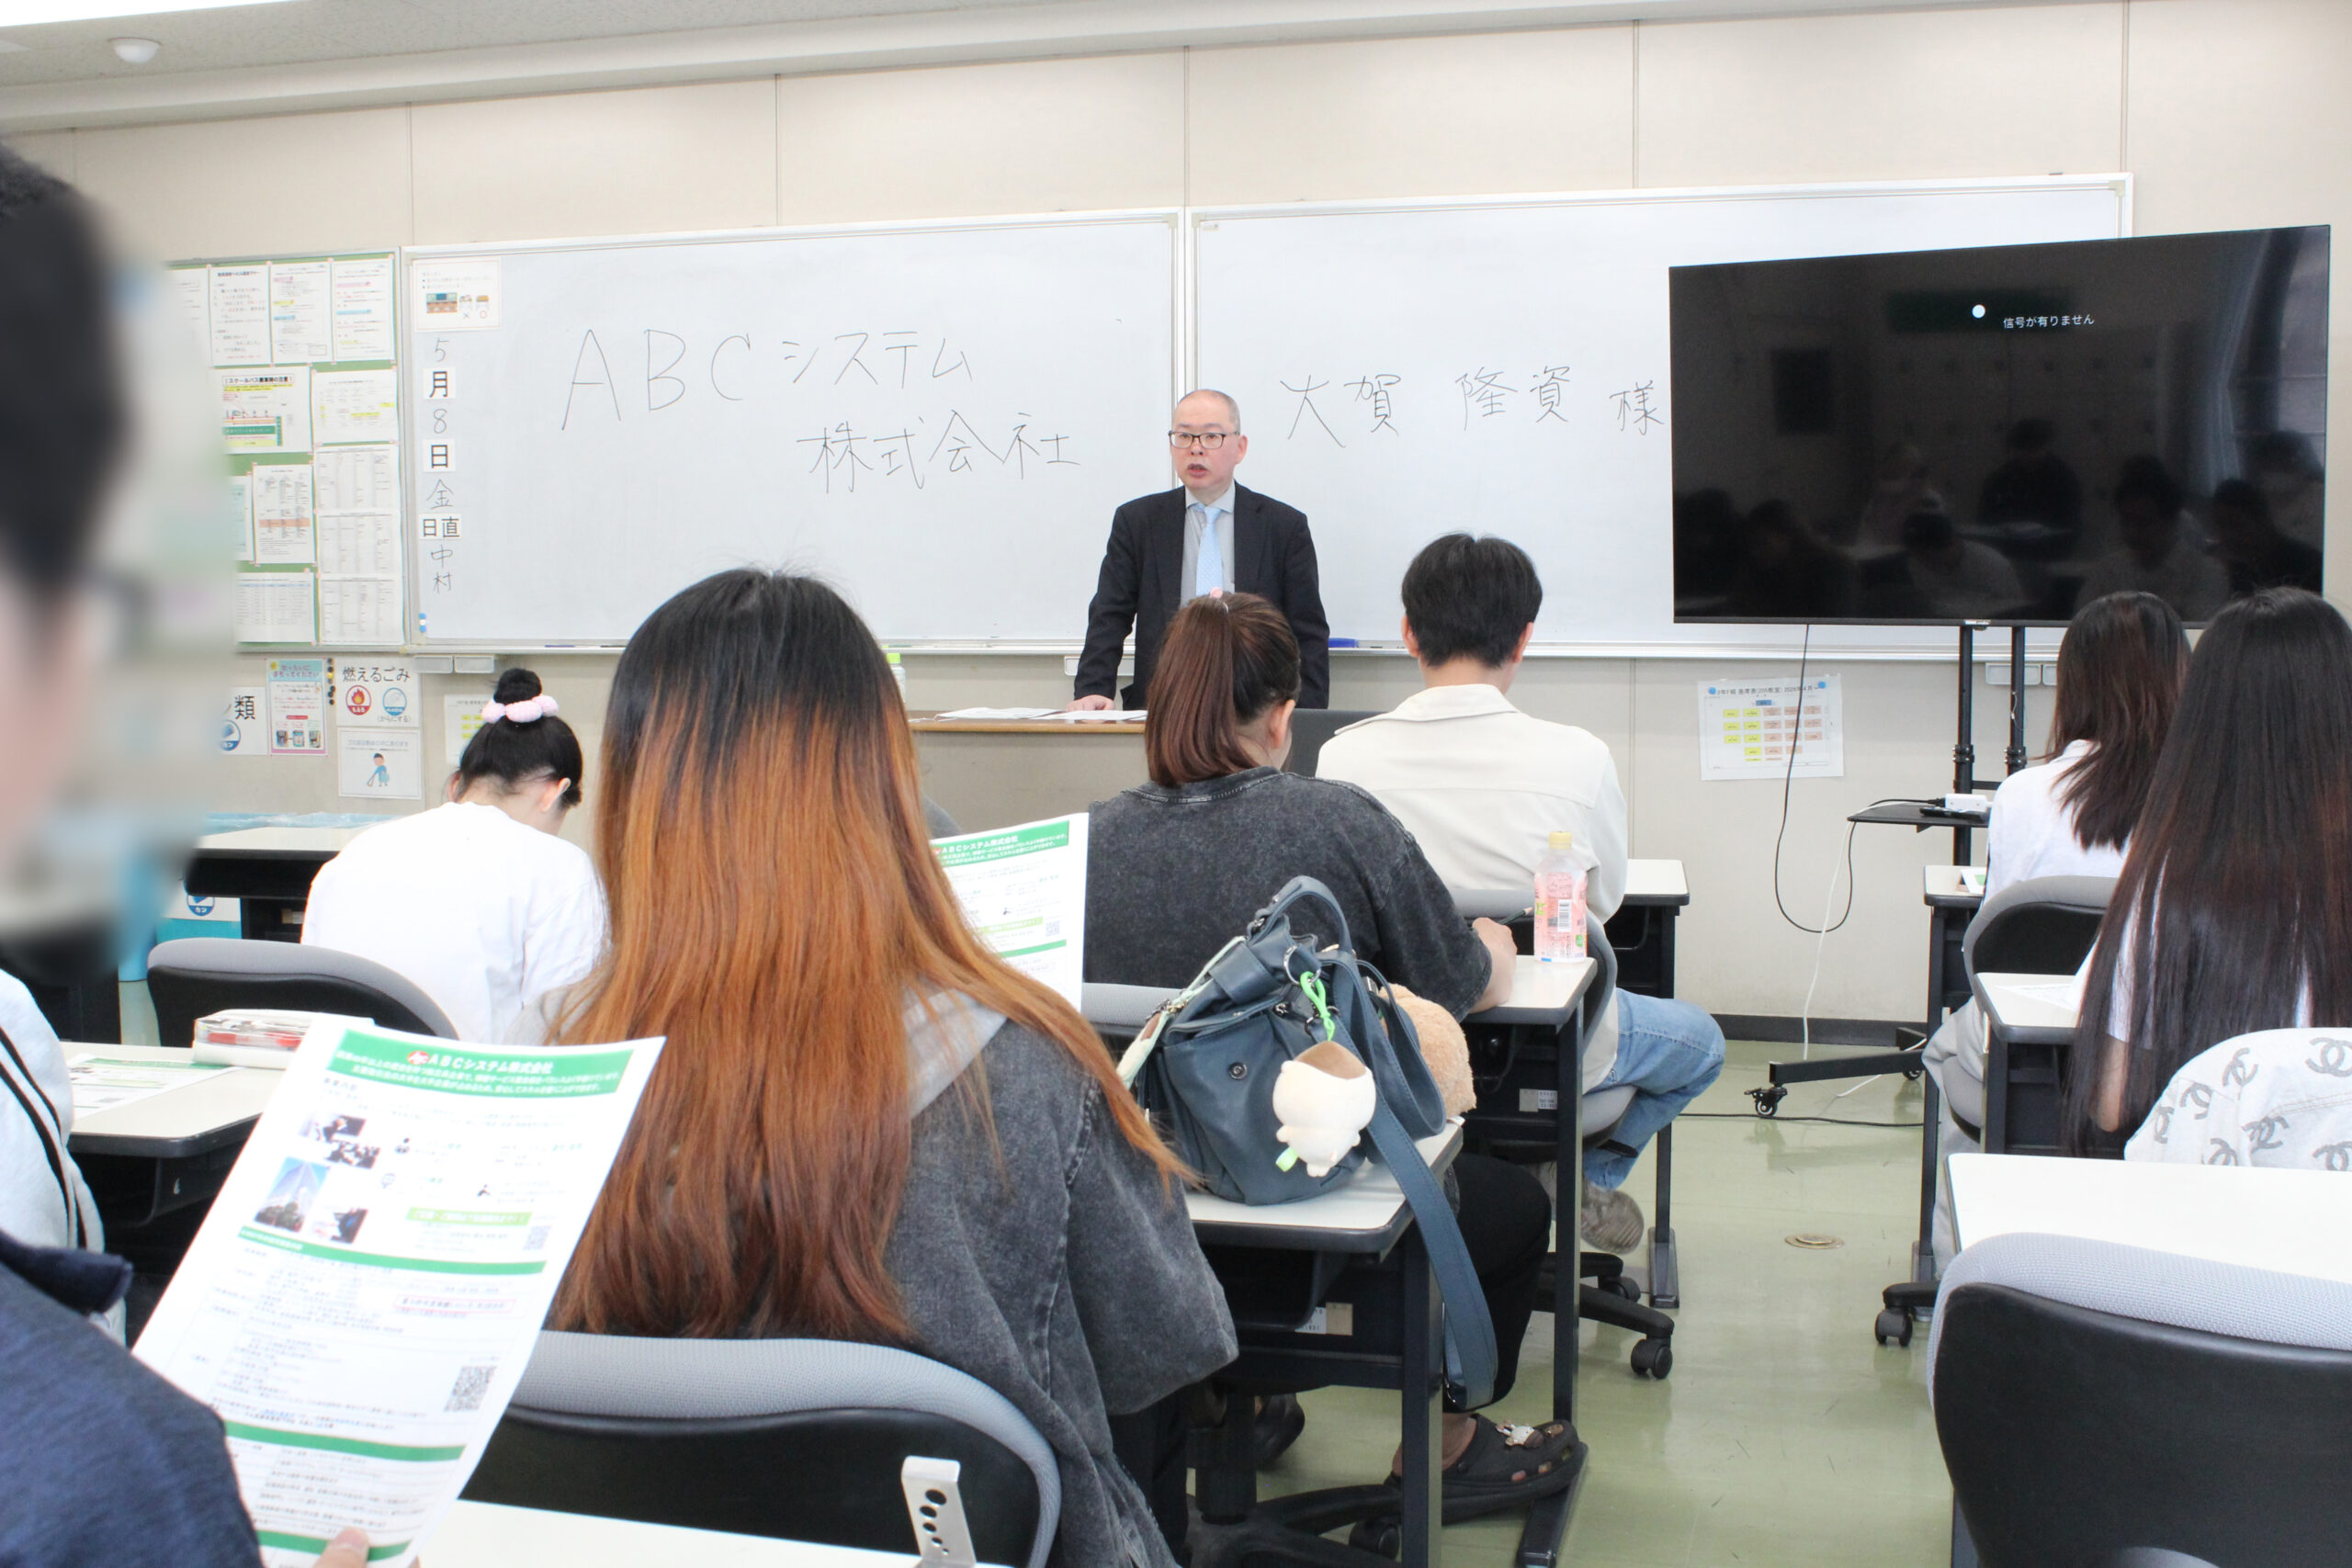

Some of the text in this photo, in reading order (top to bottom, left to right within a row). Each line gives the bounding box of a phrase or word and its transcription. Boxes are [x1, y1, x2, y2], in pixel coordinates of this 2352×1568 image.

[2003, 314, 2095, 330] 信号が有りません
[1610, 378, 1667, 437] 様
[797, 410, 1081, 493] 株式会社
[423, 517, 460, 538] 日直
[431, 545, 454, 594] 中村
[342, 666, 411, 682] 燃えるごみ
